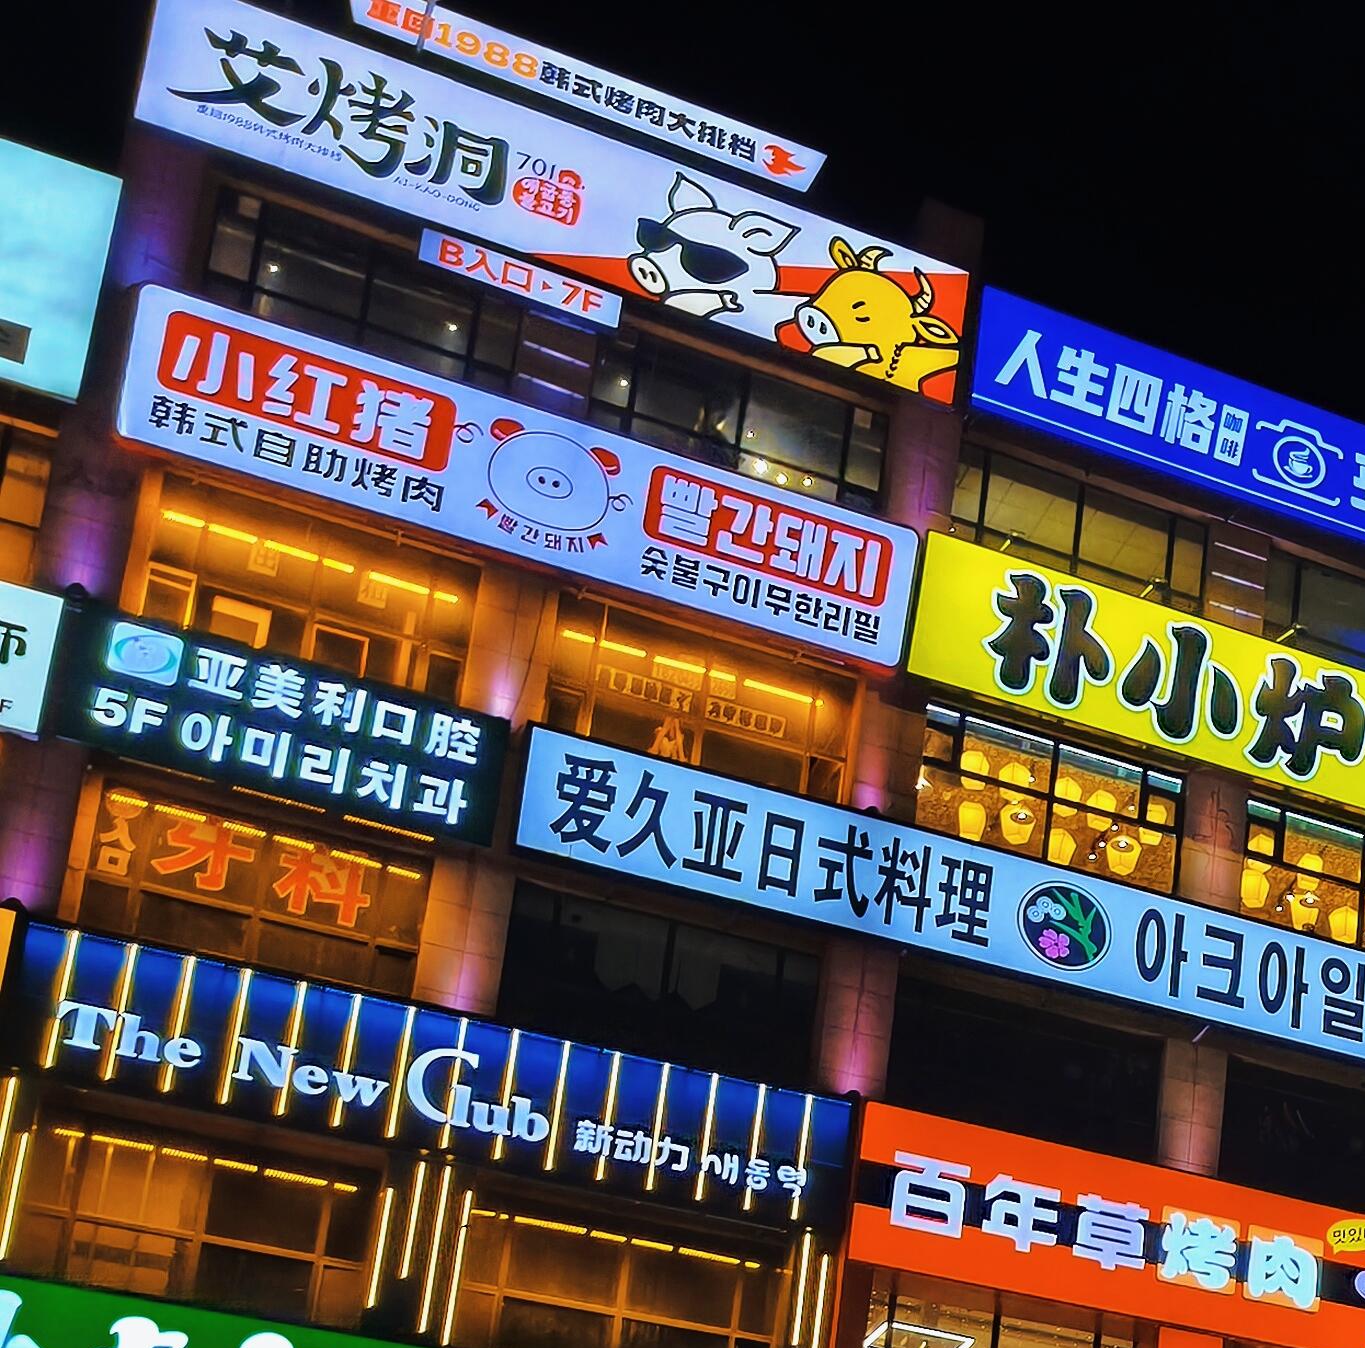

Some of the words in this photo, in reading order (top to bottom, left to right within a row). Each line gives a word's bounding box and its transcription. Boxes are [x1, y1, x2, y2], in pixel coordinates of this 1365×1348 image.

[166, 27, 510, 205] 艾烤洞
[517, 152, 557, 179] 701
[149, 393, 445, 513] 韩式自助烤肉
[171, 321, 436, 461] 小红猪
[994, 329, 1220, 456] 人生四格
[640, 545, 882, 646] 숯불구이무한리필
[661, 473, 886, 600] 빨간돼지
[91, 686, 168, 735] 5F
[180, 716, 468, 826] 아미리치과
[187, 646, 482, 766] 亚美利口腔
[151, 816, 372, 928] 牙科
[550, 753, 993, 947] 爱久亚日式料理
[58, 1000, 200, 1068] The
[233, 1036, 390, 1107] New
[407, 1048, 550, 1143] Club
[575, 1121, 689, 1171] 新动力
[890, 1150, 1318, 1310] 百年草烤肉
